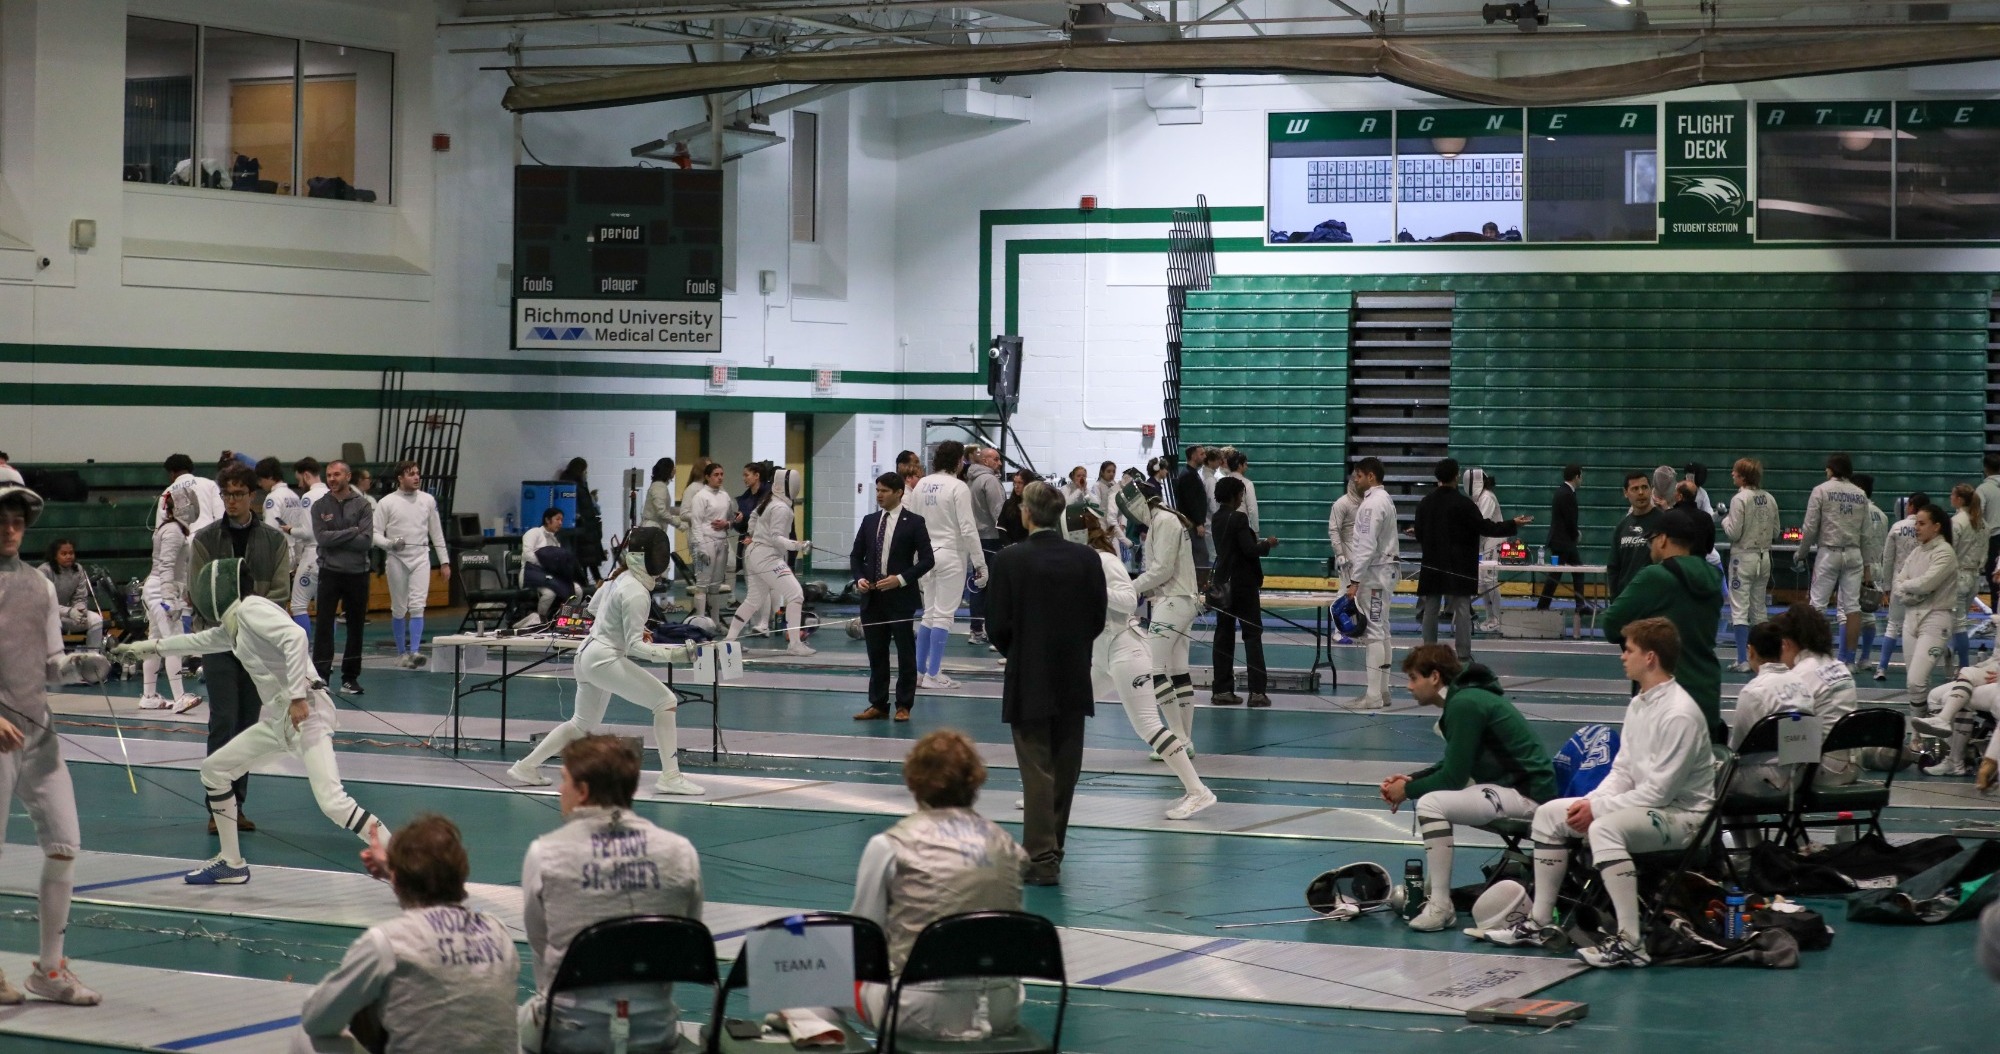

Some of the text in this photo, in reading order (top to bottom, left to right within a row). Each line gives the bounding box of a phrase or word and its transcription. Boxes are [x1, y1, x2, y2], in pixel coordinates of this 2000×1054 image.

[1677, 114, 1735, 135] FLIGHT
[1684, 139, 1728, 159] DECK
[600, 226, 640, 241] period
[1672, 222, 1739, 233] STUDENT SECTION
[522, 276, 553, 292] fouls
[601, 277, 639, 293] player
[686, 279, 716, 295] fouls
[524, 307, 713, 329] Richmond University
[595, 328, 713, 343] Medical Center
[1827, 491, 1865, 504] WOODWARD
[773, 958, 827, 974] TEAM A
